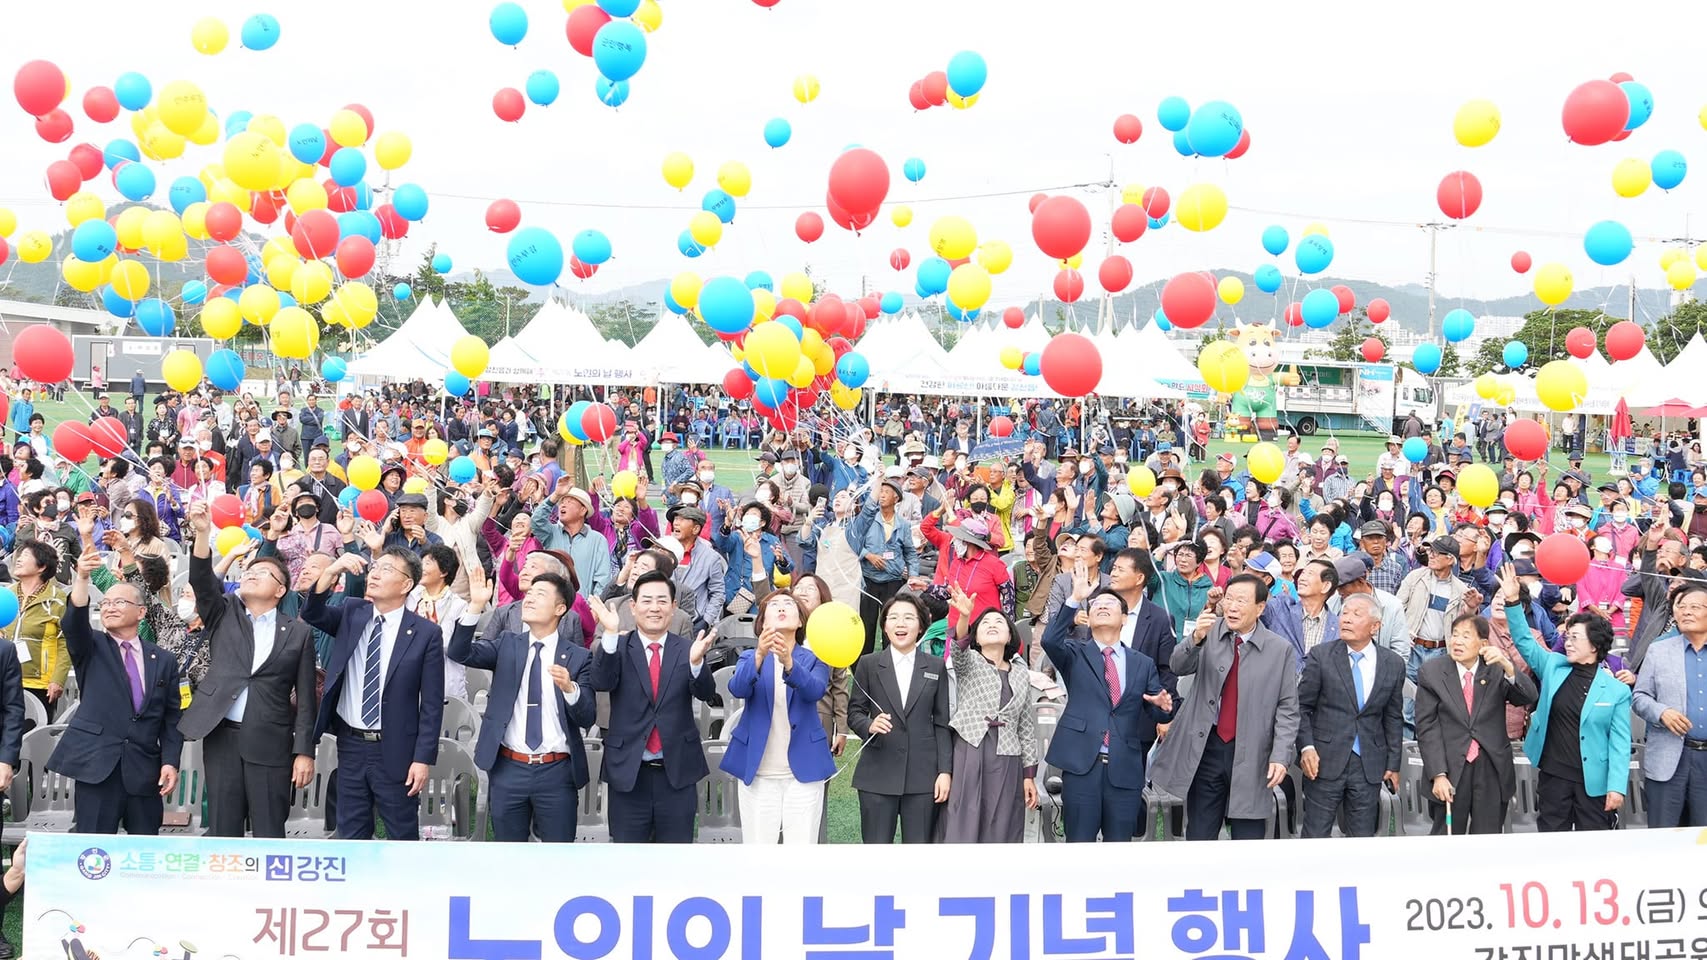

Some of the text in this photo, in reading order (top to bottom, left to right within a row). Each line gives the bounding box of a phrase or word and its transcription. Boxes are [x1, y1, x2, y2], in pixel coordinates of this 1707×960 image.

[573, 368, 601, 378] 노인의
[603, 368, 612, 379] 날
[614, 368, 632, 379] 행사
[268, 856, 290, 879] 신
[297, 857, 346, 882] 강진
[1406, 897, 1493, 931] 2023.
[253, 908, 409, 957] 제27회
